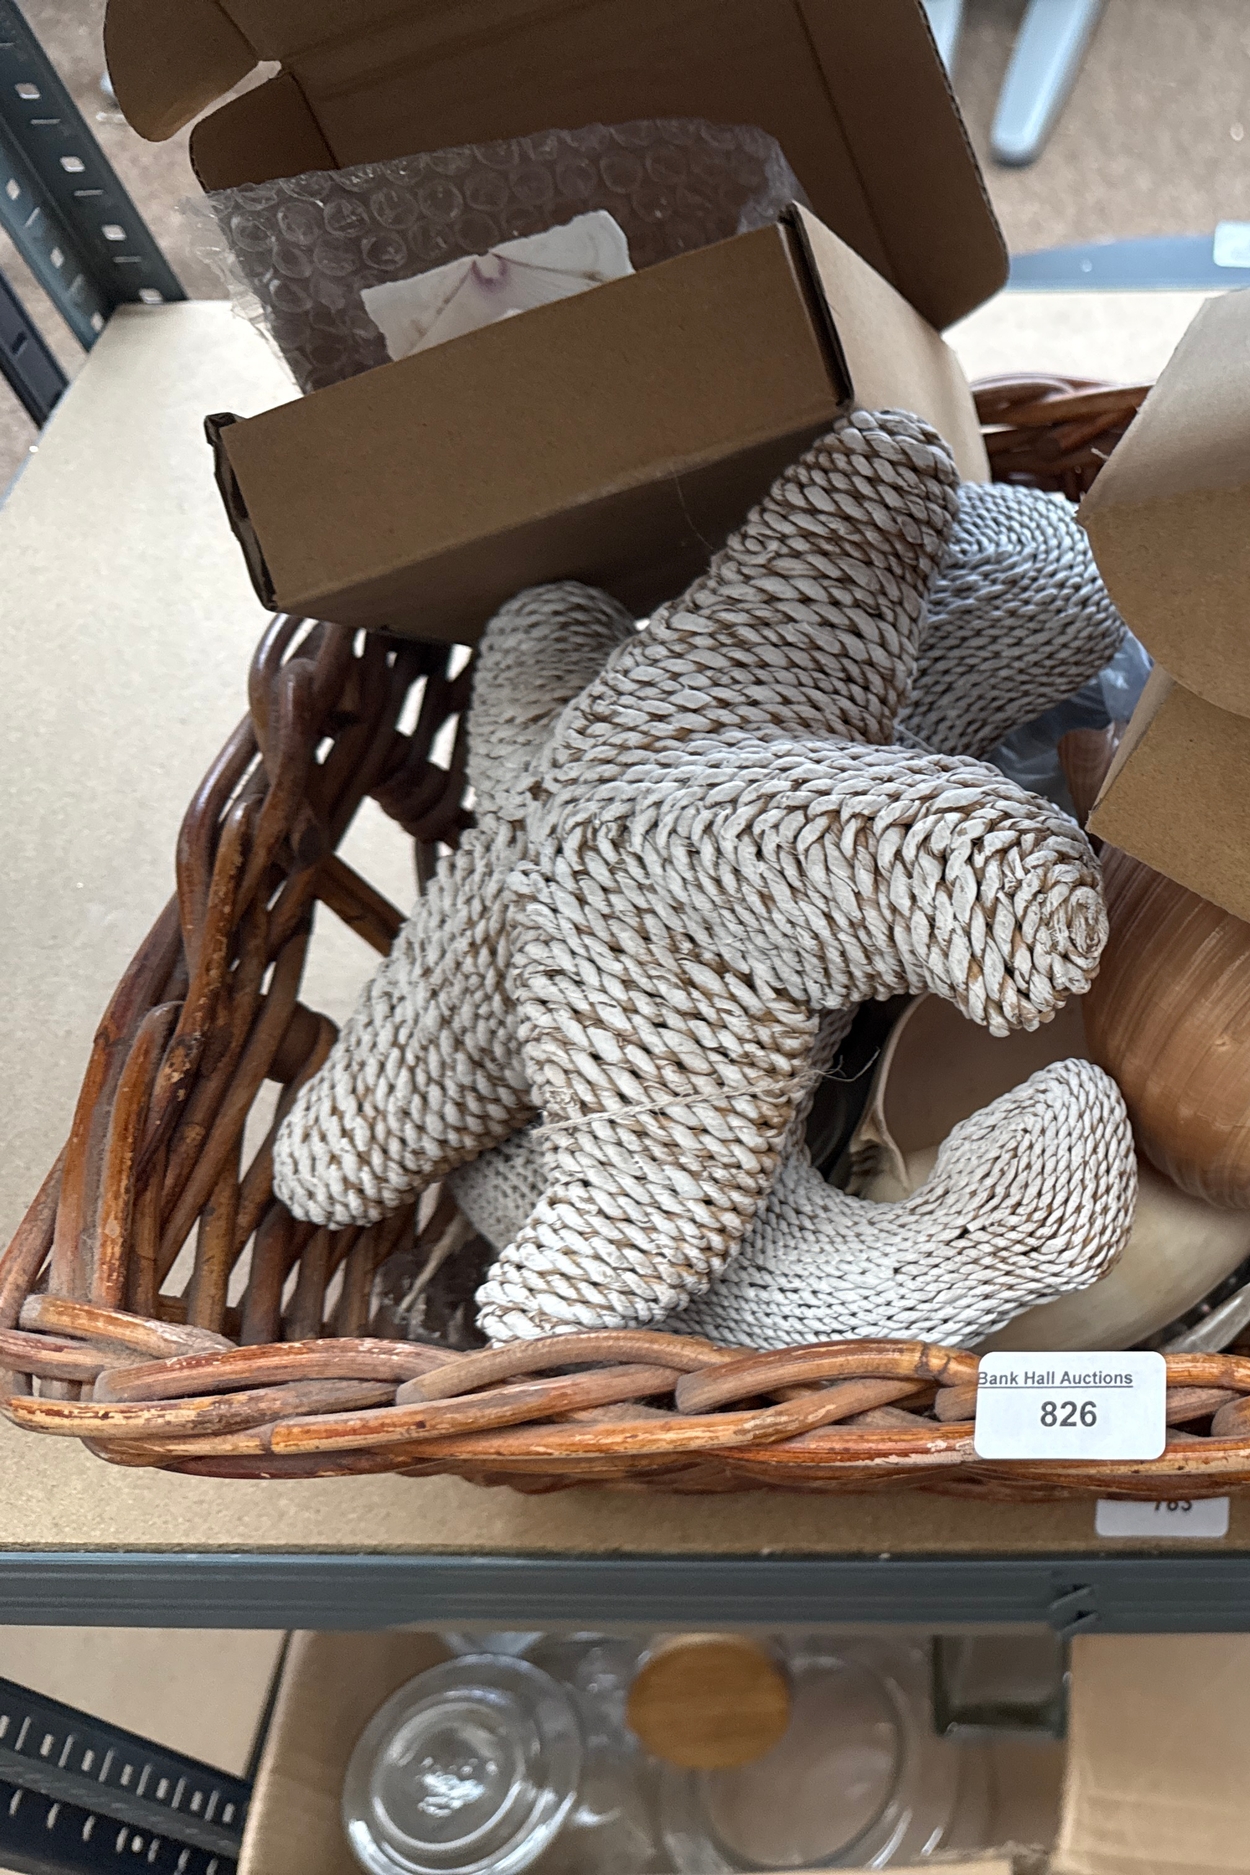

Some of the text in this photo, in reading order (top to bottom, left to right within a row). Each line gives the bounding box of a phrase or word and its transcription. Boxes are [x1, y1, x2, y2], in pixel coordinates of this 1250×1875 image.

[978, 1371, 1133, 1385] Bank Hall Auctions
[1040, 1400, 1097, 1427] 826
